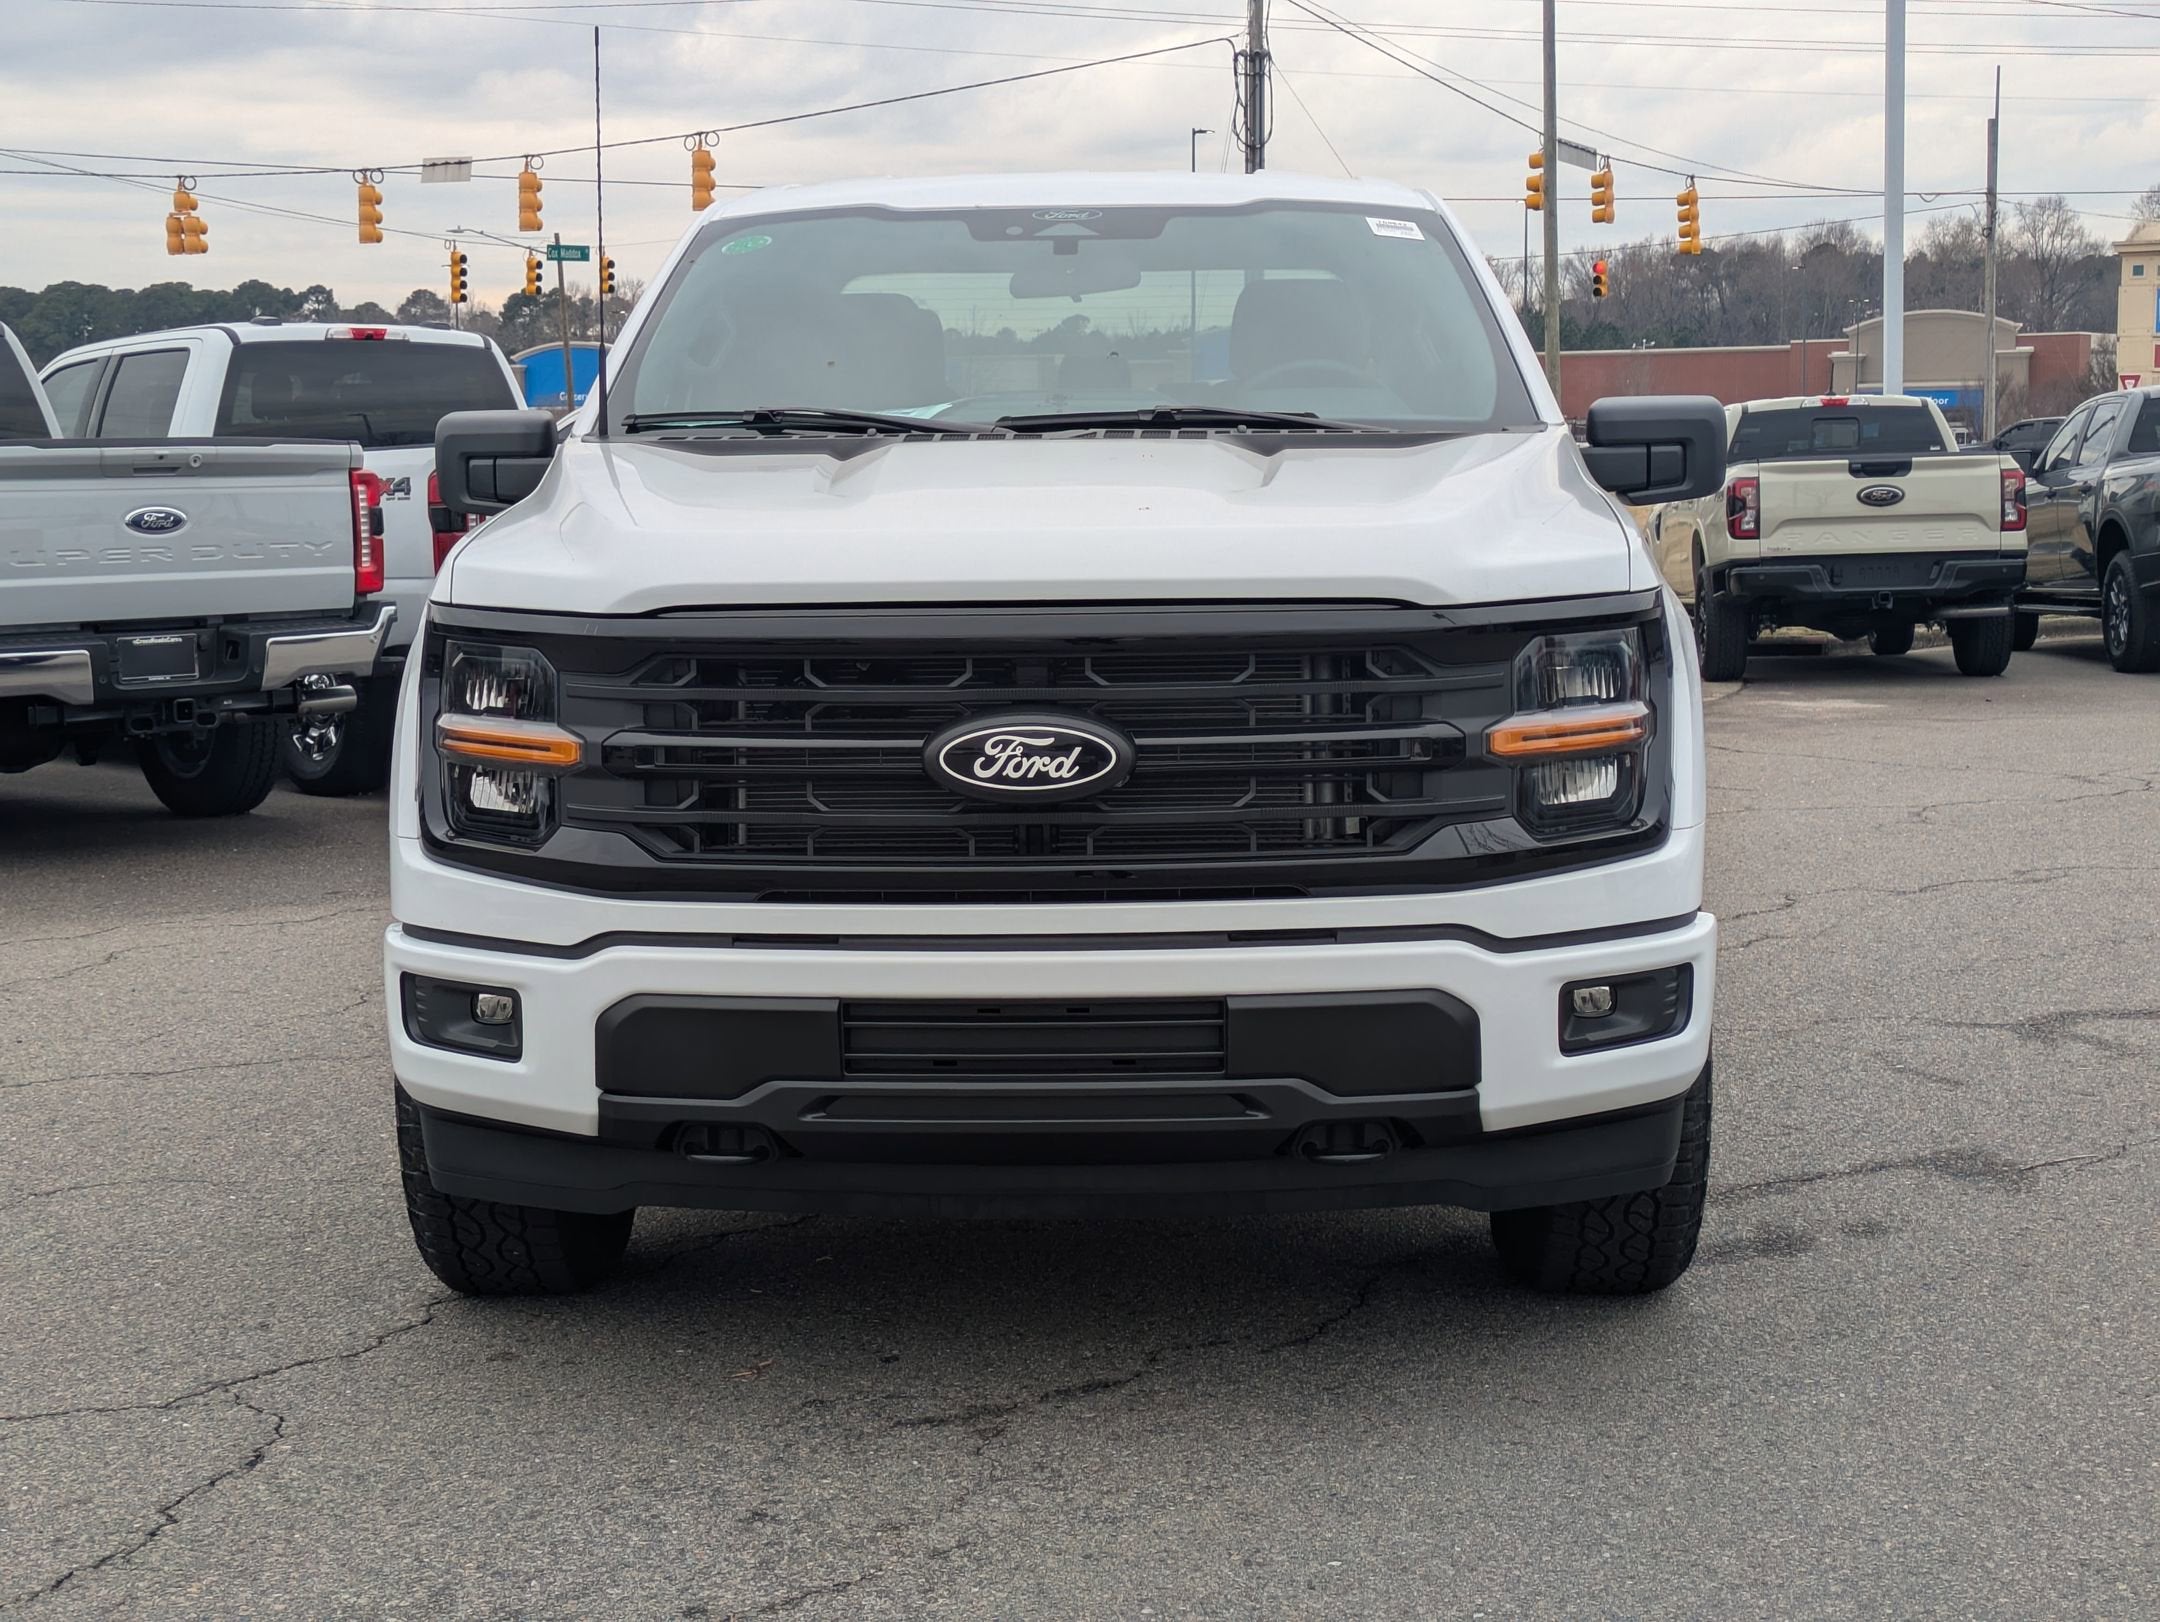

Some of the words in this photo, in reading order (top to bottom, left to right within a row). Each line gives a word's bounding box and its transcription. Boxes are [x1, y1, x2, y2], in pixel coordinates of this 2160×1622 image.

[141, 513, 174, 528] Ford
[1783, 528, 1978, 546] RANGER
[191, 541, 333, 560] DUTY
[973, 735, 1082, 779] Ford
